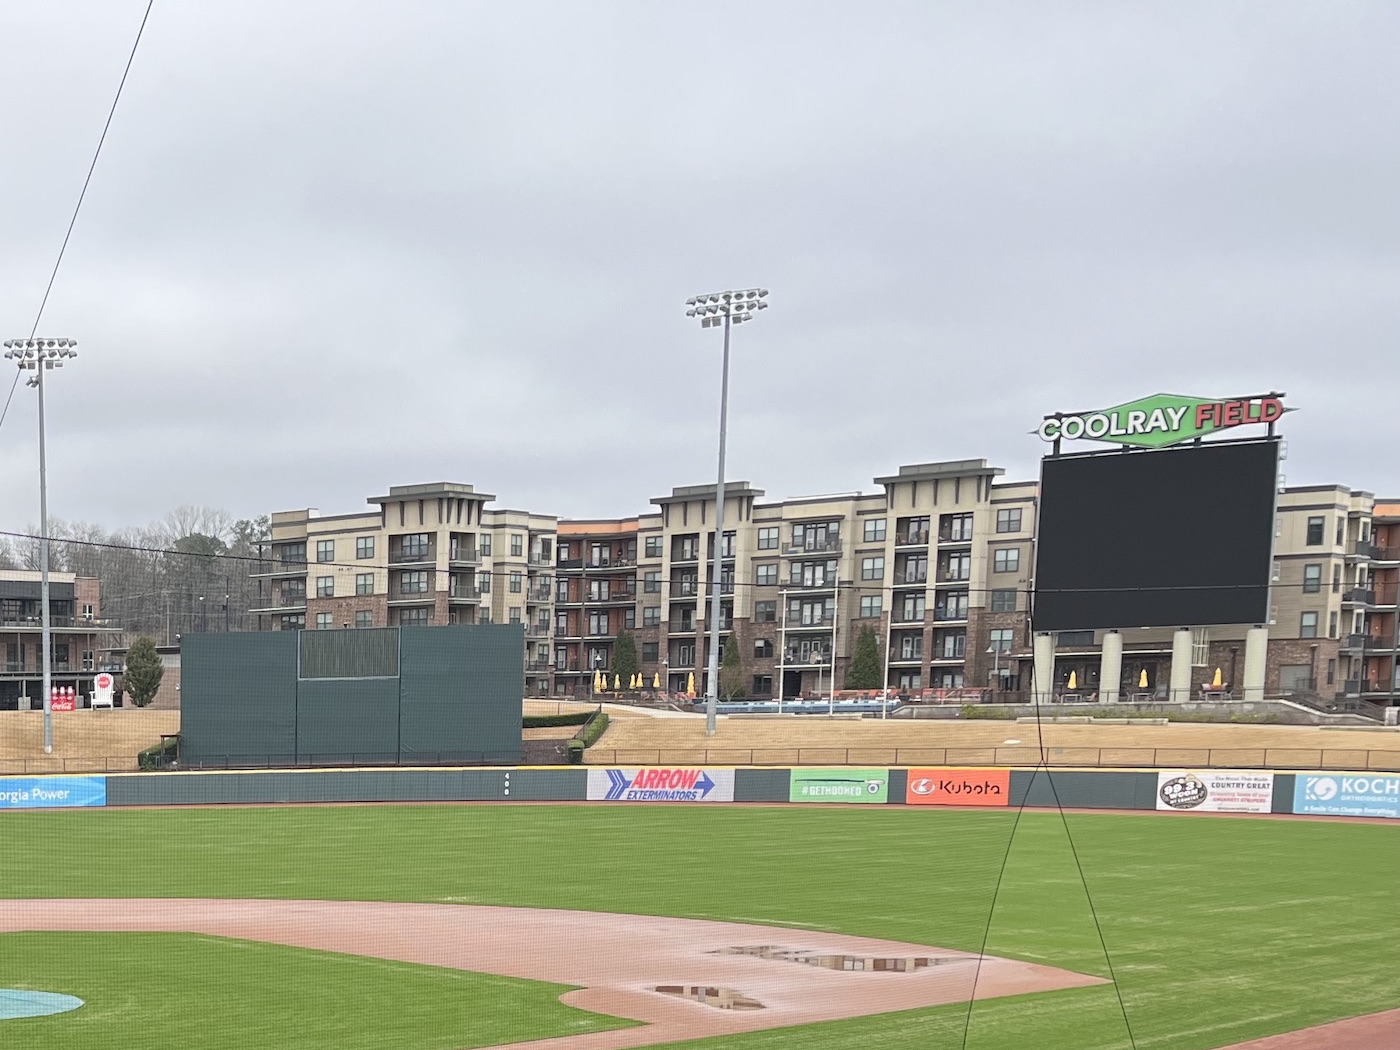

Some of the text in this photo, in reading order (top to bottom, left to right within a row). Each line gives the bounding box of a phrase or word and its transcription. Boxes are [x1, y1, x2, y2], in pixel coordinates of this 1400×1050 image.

[1038, 398, 1284, 442] COOLRAY FIELD
[631, 769, 702, 789] ARROW
[802, 786, 862, 796] #GETHOOKED
[939, 781, 1001, 794] Kubota
[1341, 777, 1400, 794] KOCH
[32, 788, 70, 800] Power
[626, 790, 698, 800] EXTERMINATORS
[1340, 795, 1398, 803] ORTHODONTICS
